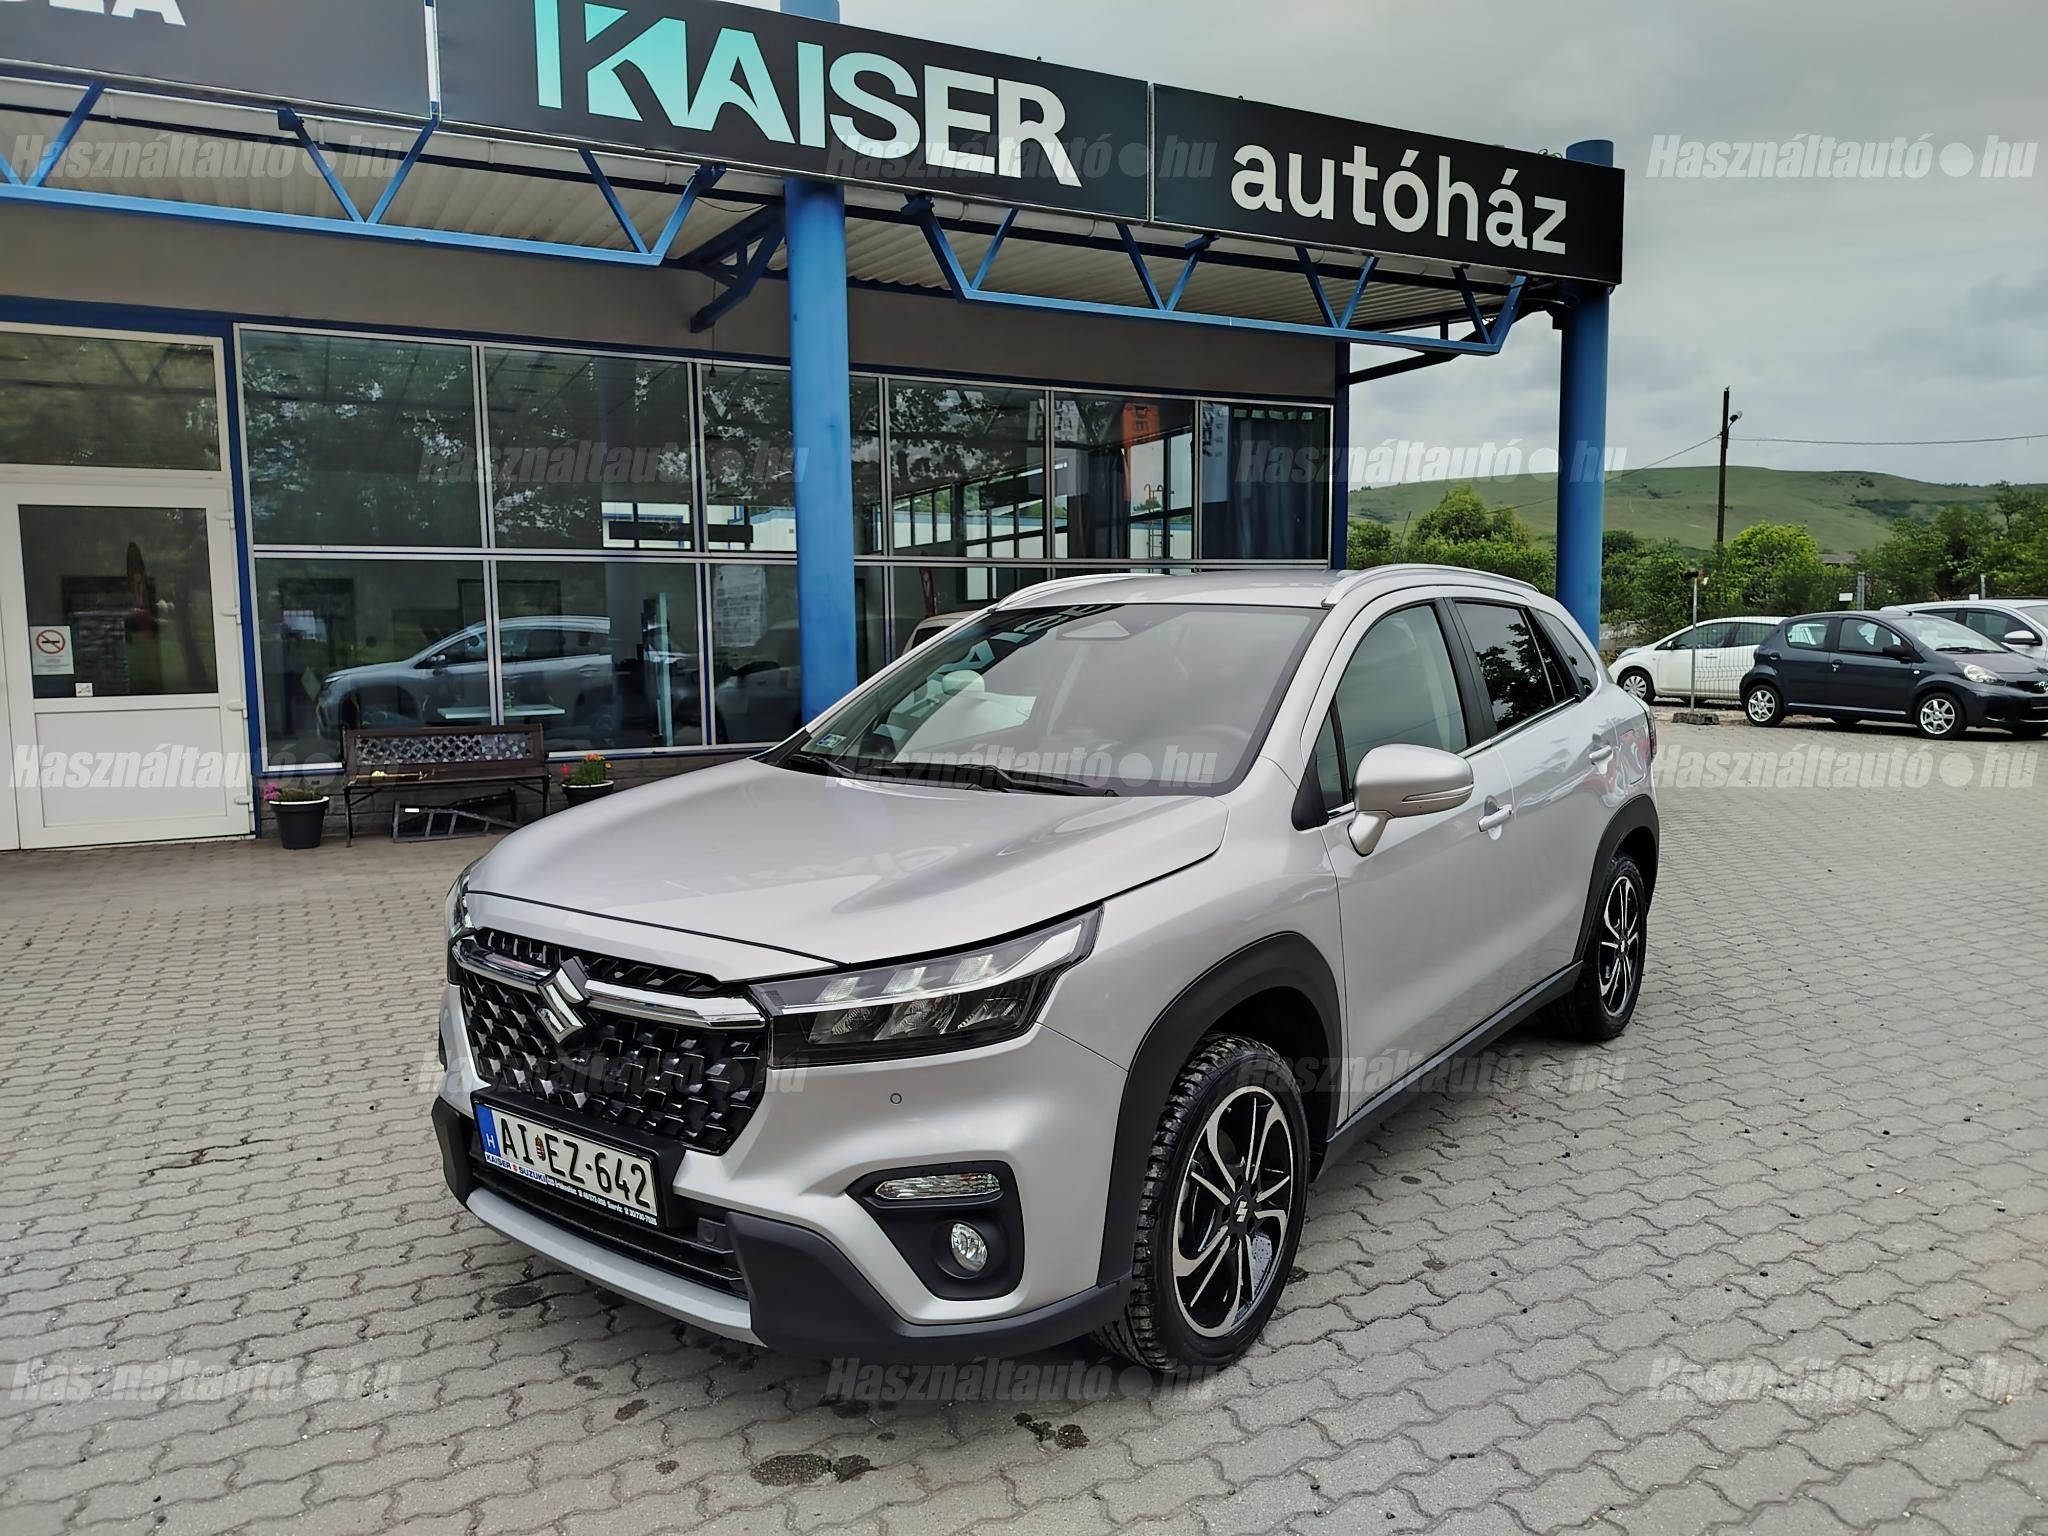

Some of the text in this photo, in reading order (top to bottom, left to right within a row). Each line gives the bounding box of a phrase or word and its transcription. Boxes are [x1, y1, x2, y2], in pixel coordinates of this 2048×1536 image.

[535, 0, 1082, 187] KAISER
[1230, 145, 1567, 255] autóház
[487, 1133, 496, 1150] H
[500, 1117, 535, 1166] AI
[486, 1153, 546, 1183] KAISER SUZUKI
